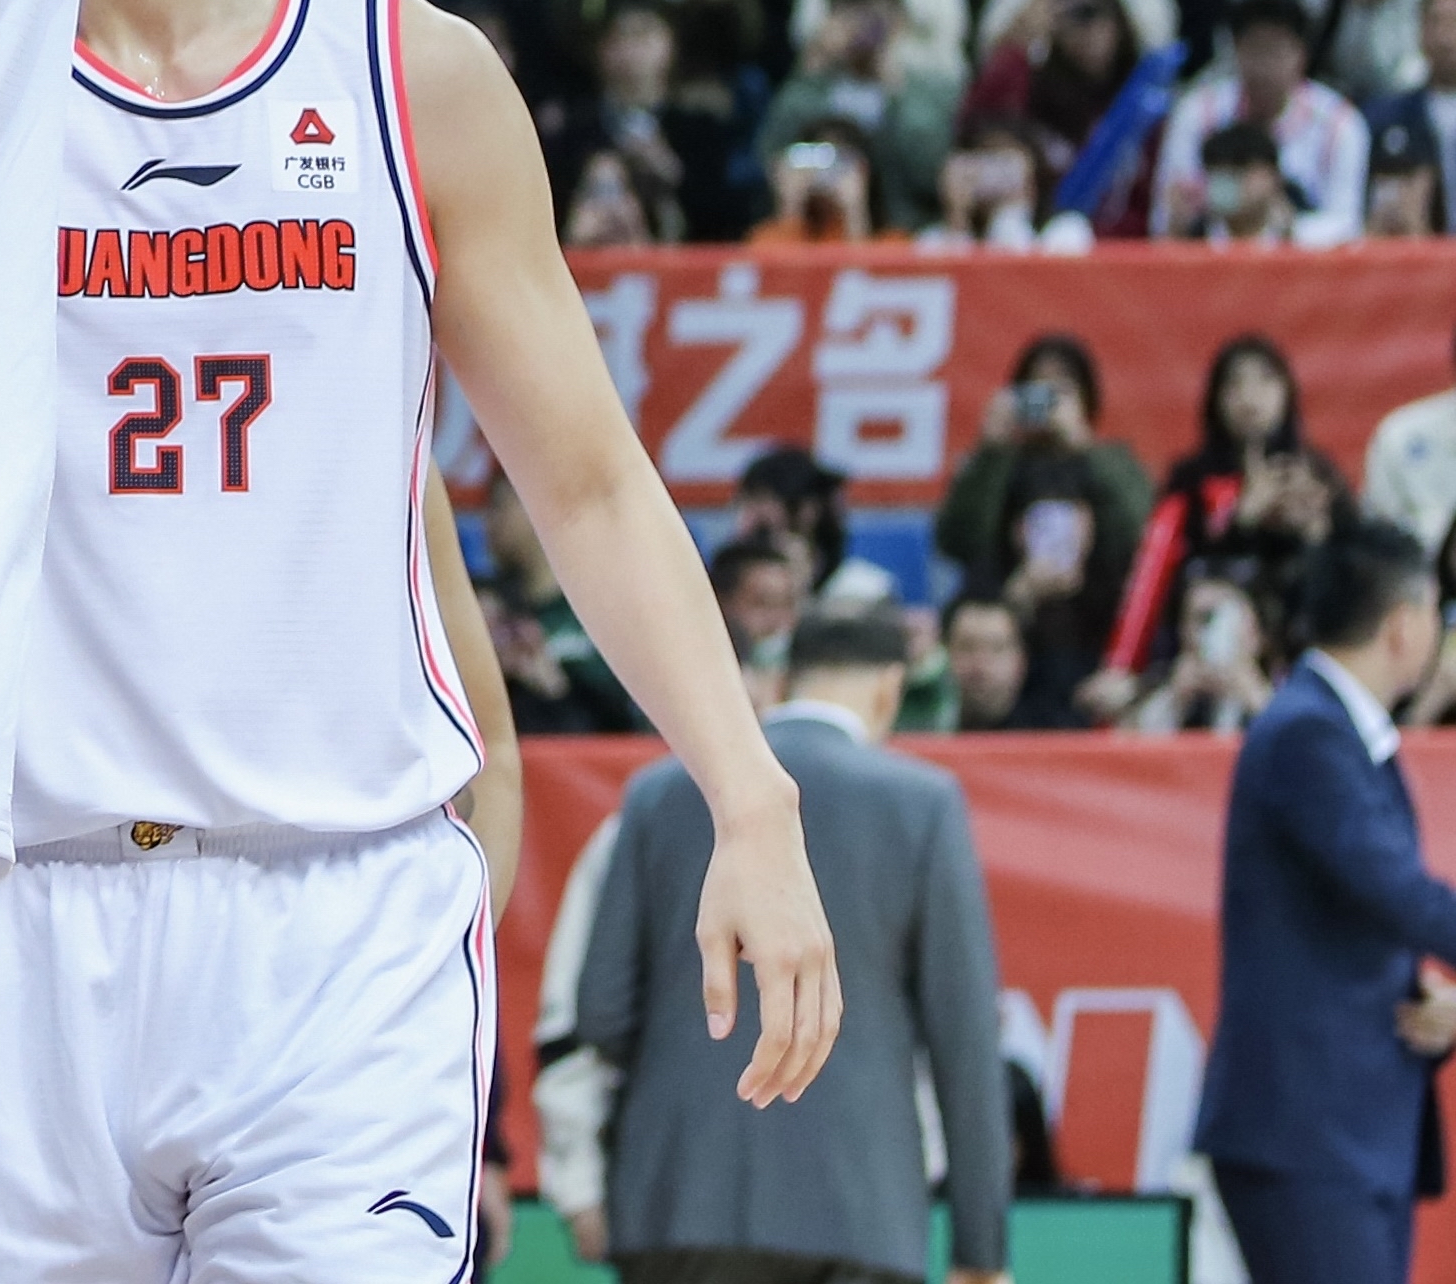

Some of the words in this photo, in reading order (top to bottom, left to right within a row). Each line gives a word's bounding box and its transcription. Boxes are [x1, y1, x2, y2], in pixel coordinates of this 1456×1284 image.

[284, 156, 346, 171] 广发银行
[297, 174, 335, 189] CGB
[57, 219, 356, 298] UANGDONG
[107, 354, 273, 495] 27
